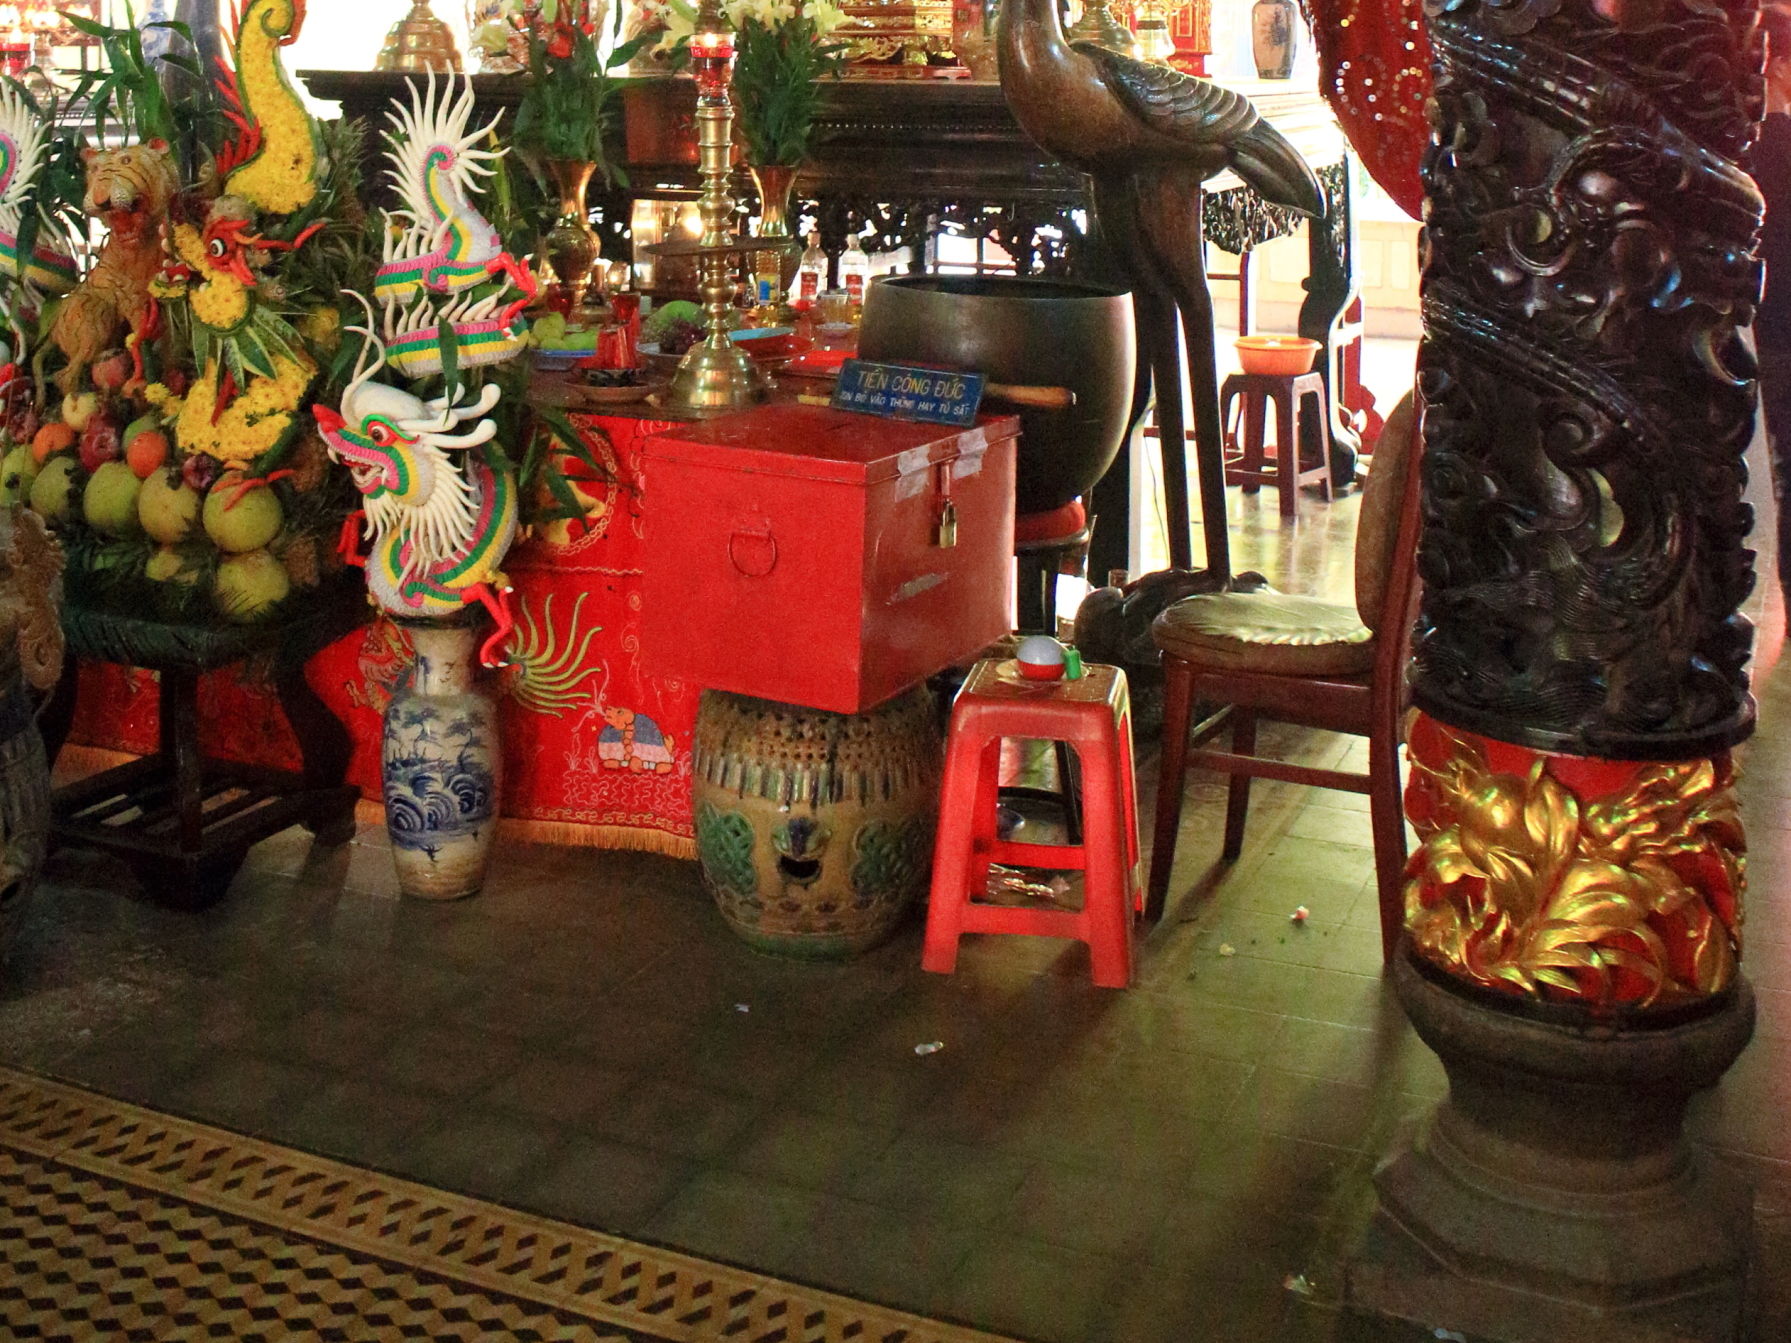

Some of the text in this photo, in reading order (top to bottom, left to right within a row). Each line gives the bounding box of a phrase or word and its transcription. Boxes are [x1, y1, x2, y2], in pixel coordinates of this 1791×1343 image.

[891, 374, 931, 395] CÔNG
[934, 379, 966, 400] ĐỨC
[917, 401, 935, 413] HAY
